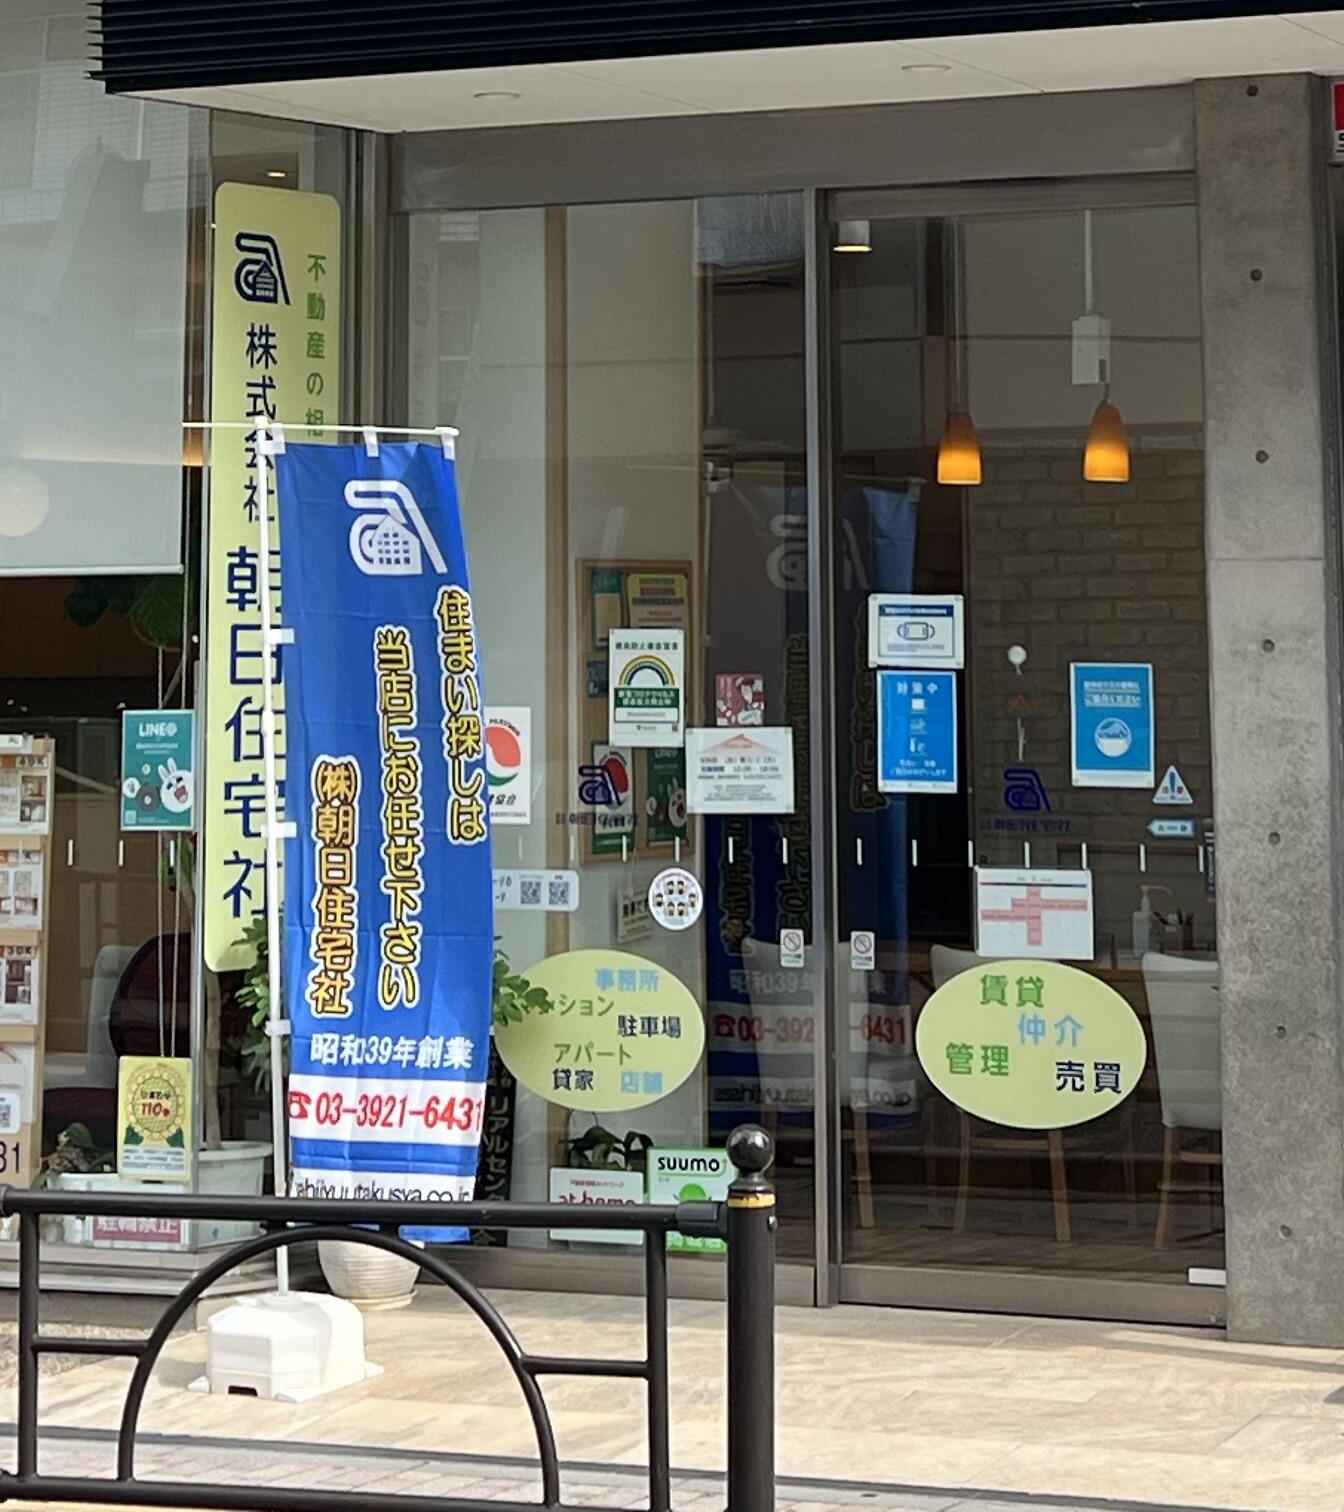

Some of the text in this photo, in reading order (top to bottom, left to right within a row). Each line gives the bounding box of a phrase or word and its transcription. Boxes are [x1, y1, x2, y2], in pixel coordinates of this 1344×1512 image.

[438, 589, 485, 841] 住まい探しは
[376, 627, 422, 1009] 当店にお任せ下さい
[595, 968, 660, 993] 事務所
[979, 974, 1044, 1008] 賃貸
[617, 1015, 682, 1039] 駐車場
[1017, 1013, 1084, 1048] 仲介
[310, 1033, 475, 1070] 昭和39年創業
[553, 1041, 633, 1066] アパート
[945, 1041, 1009, 1077] 管理
[552, 1069, 595, 1092] 貸家
[619, 1071, 663, 1095] 店舗
[1055, 1060, 1123, 1095] 売買
[315, 1092, 482, 1132] 03-3921-6431
